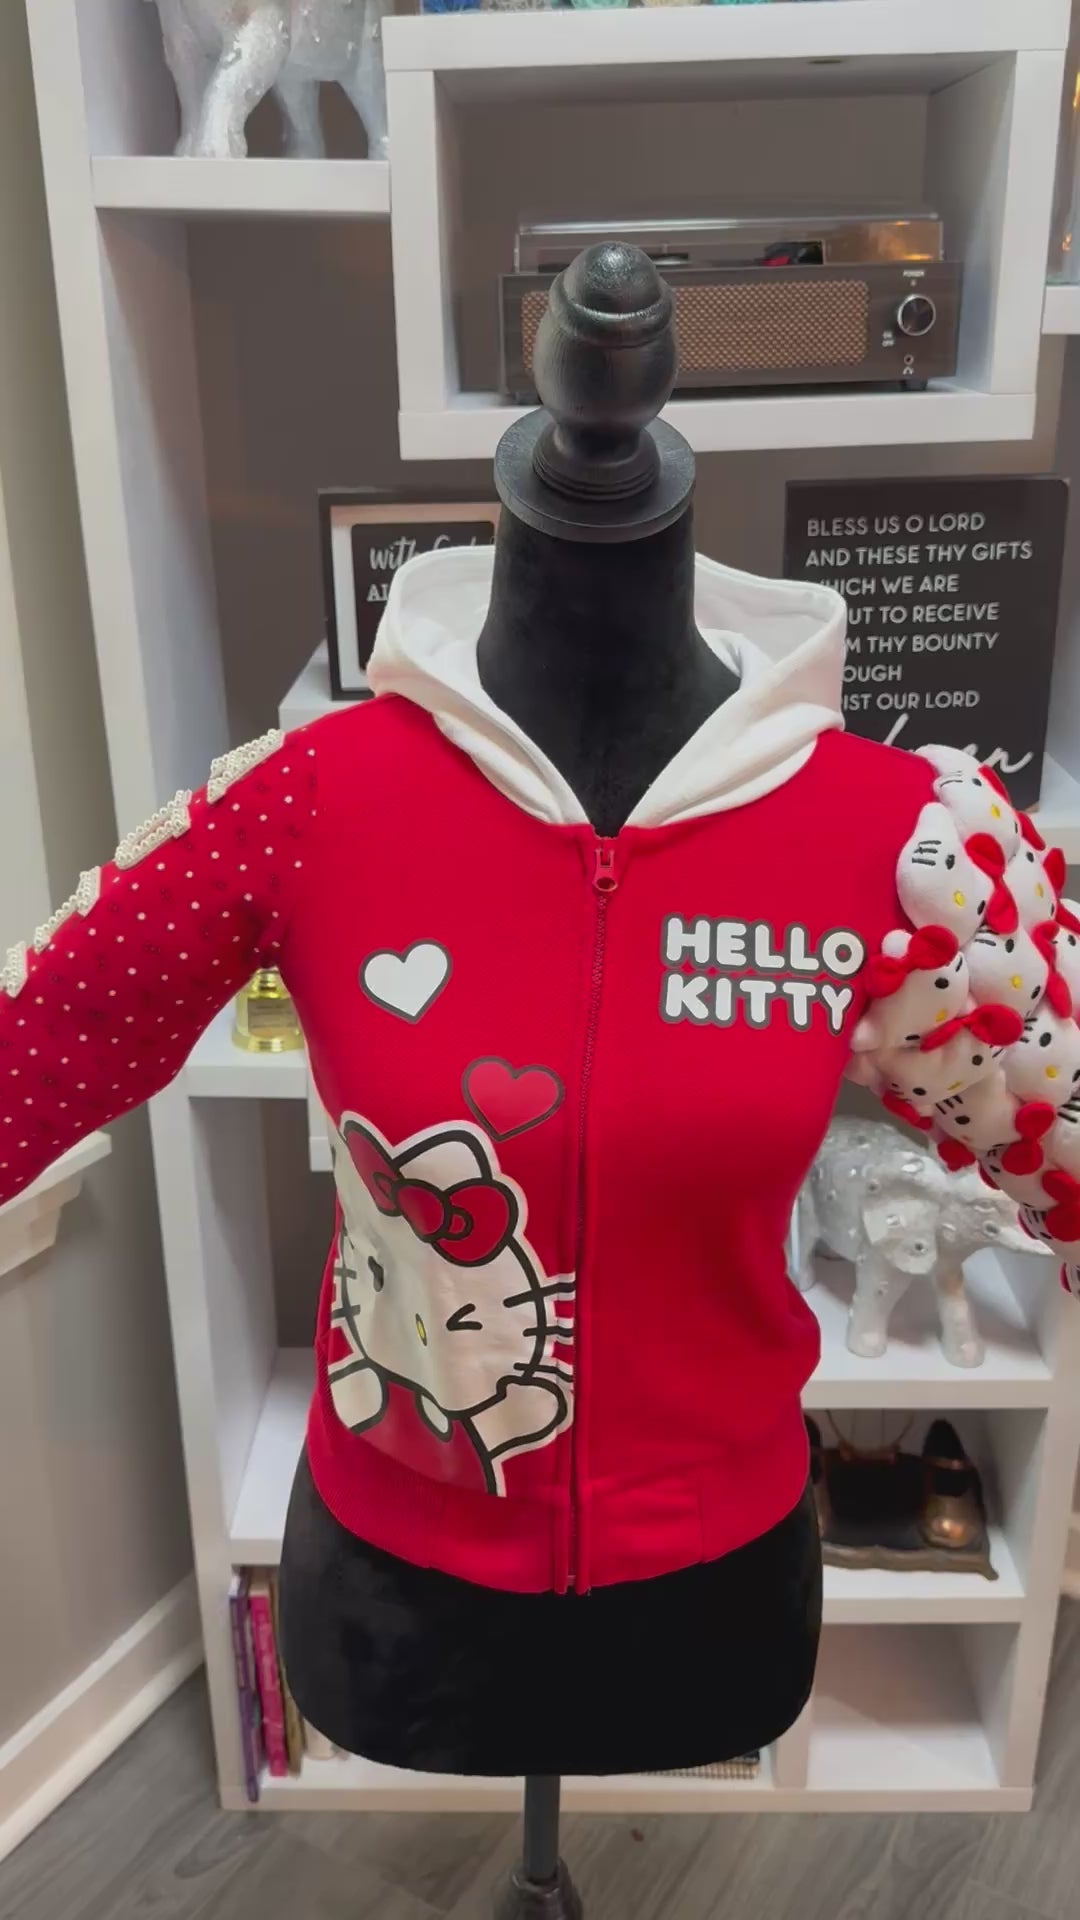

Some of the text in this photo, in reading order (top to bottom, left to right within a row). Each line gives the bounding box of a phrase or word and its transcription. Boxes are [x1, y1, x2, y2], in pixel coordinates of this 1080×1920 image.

[806, 512, 986, 537] BLESS US O LORD
[804, 540, 1034, 567] AND THESE THY GIFTS
[881, 575, 914, 595] WE
[918, 573, 960, 593] ARE
[878, 605, 908, 624] TO
[912, 601, 1000, 623] RECEIVE
[866, 635, 909, 653] THY
[911, 631, 1000, 653] BOUNTY
[843, 664, 903, 683] OUGH
[876, 690, 919, 710] OUR
[924, 689, 981, 709] LORD
[663, 915, 866, 978] HELLO
[663, 972, 854, 1033] KITTY
